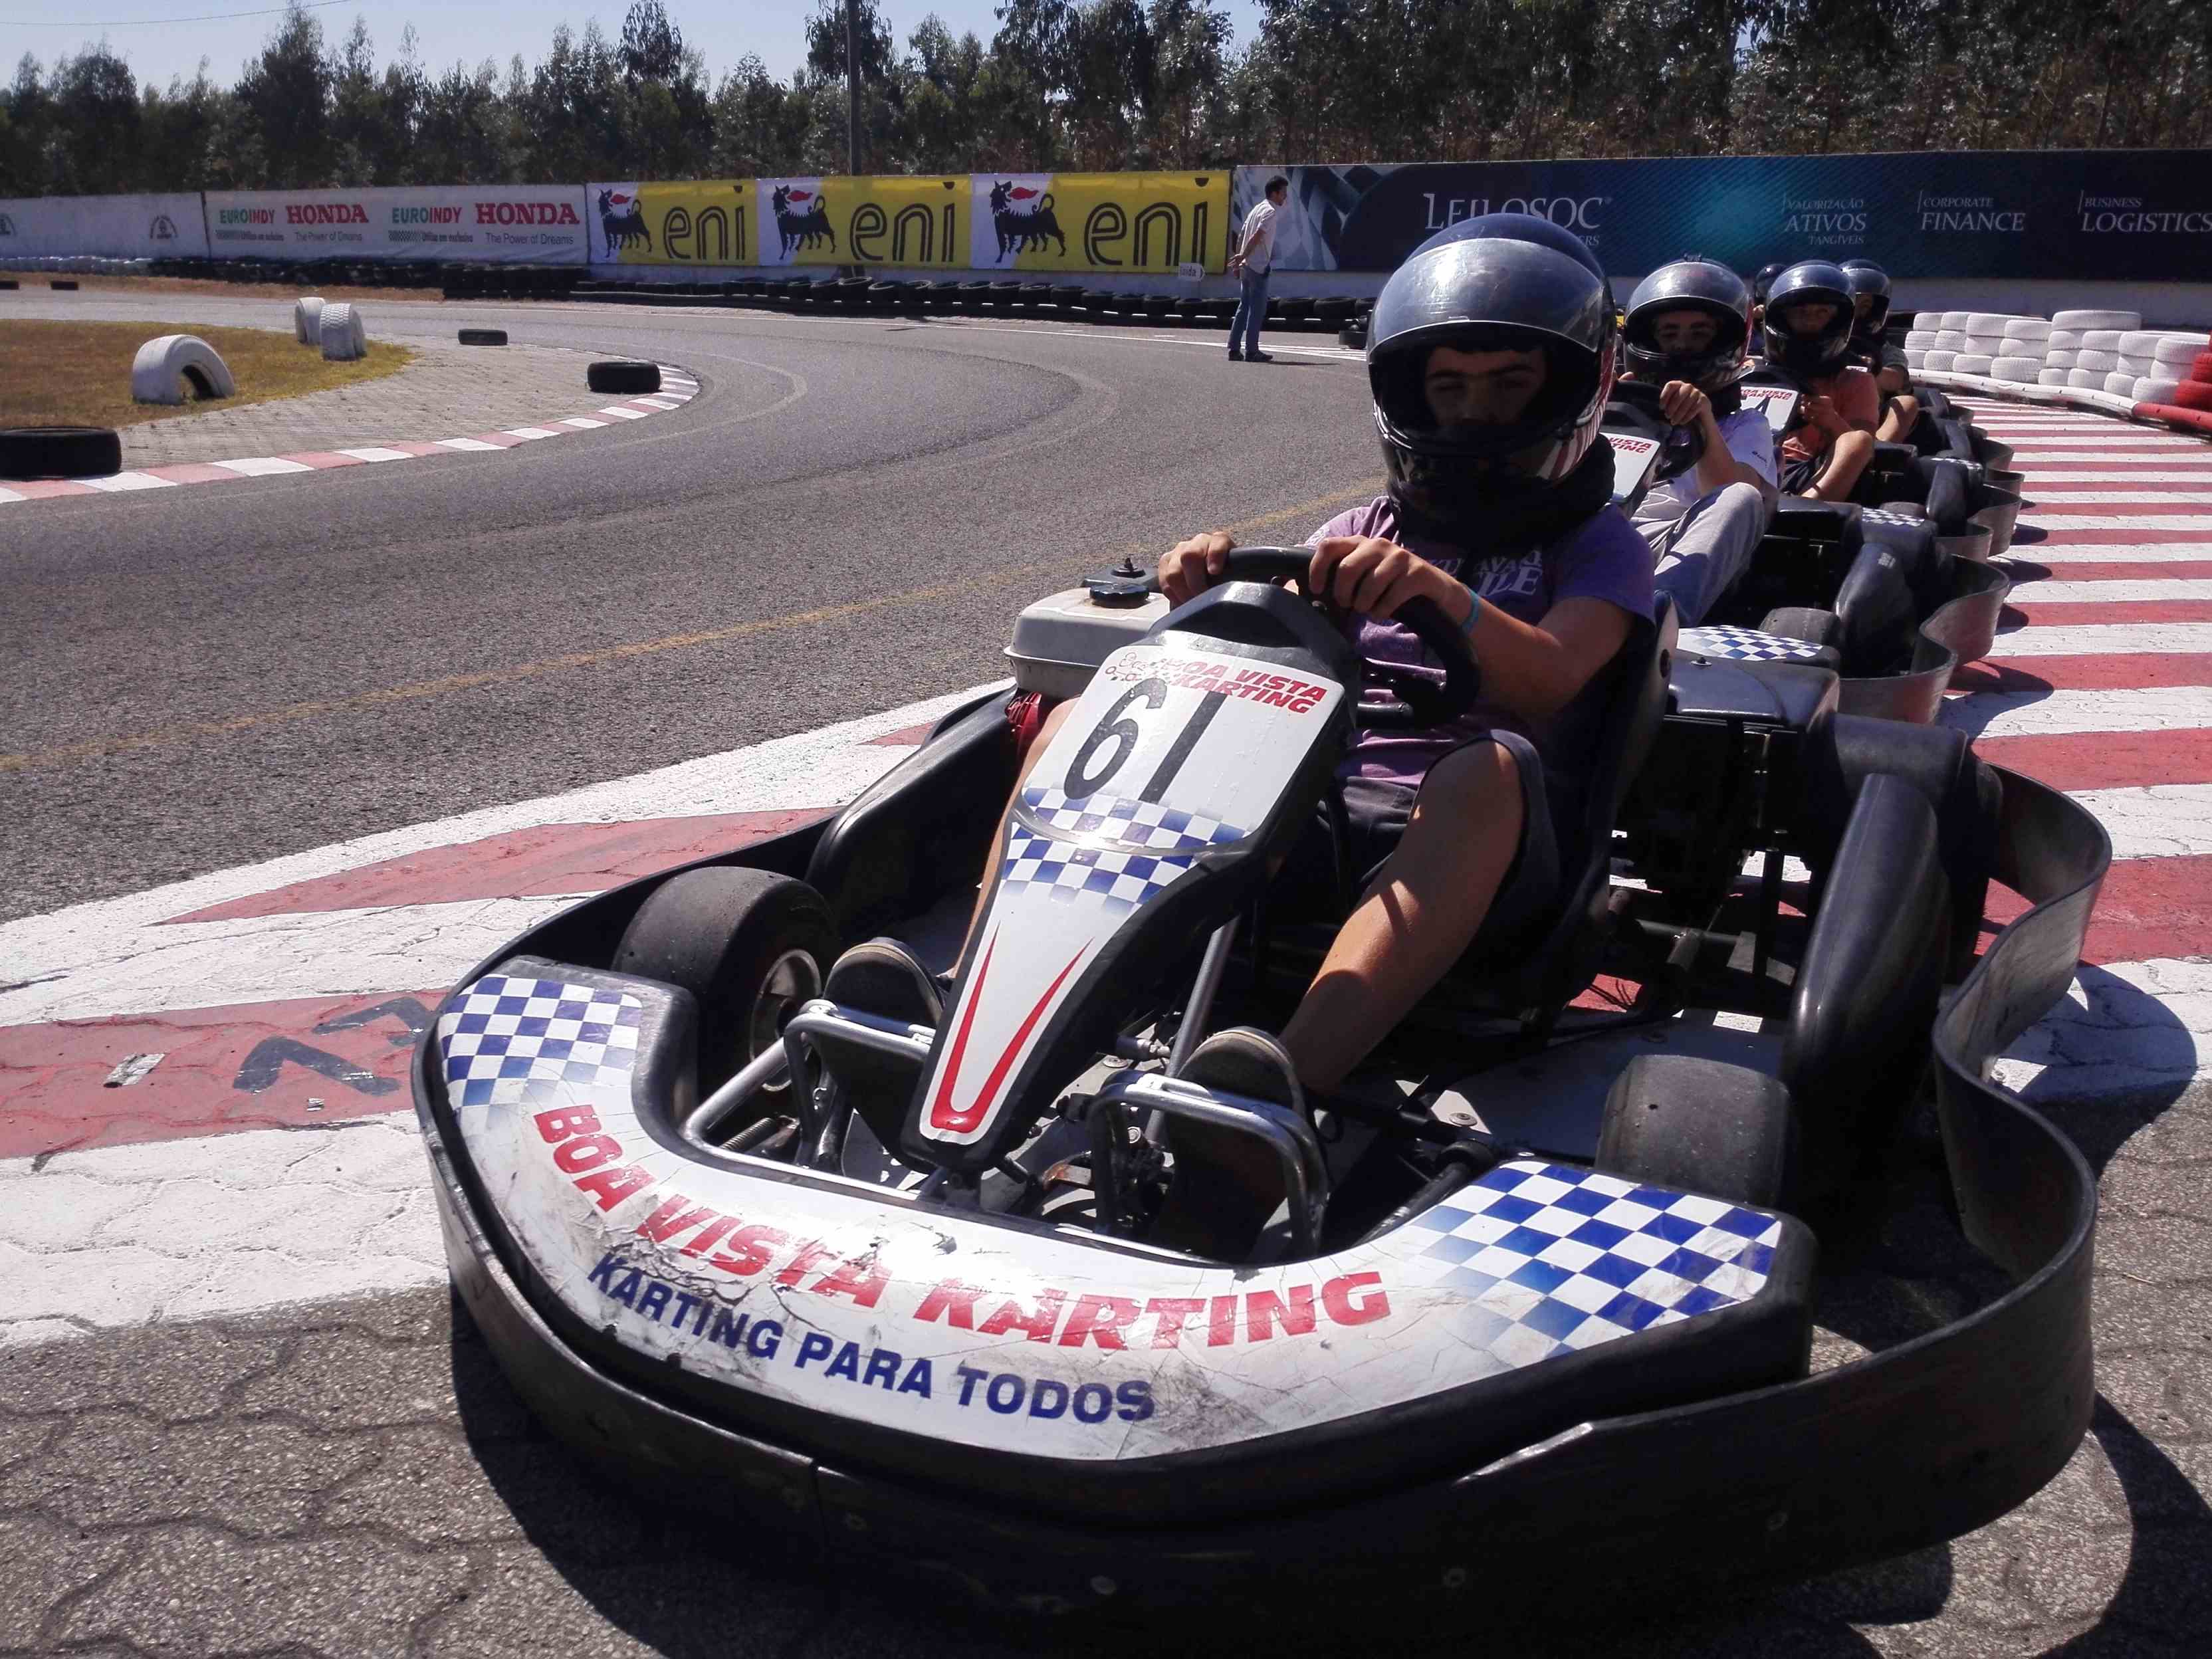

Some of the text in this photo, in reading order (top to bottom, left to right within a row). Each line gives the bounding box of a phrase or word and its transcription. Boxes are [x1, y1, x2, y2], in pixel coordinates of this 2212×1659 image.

[1923, 197, 1995, 207] CORPORATE
[2084, 196, 2143, 207] BUSINESS
[219, 209, 275, 224] EUROINDY
[286, 204, 369, 225] HONDA
[391, 207, 463, 224] EUROINDY
[475, 202, 580, 225] HONDA
[663, 185, 744, 260] eni
[850, 181, 954, 262] eni
[1084, 177, 1208, 266] eni
[1784, 213, 1867, 232] ATIVOS
[1919, 212, 2027, 232] FINANCE
[2080, 212, 2212, 233] LOGISTICS
[485, 233, 574, 245] The Power of Dreams
[1609, 437, 1652, 449] VISTA
[1170, 674, 1317, 715] KARTING
[1235, 669, 1327, 702] VISTA
[1063, 677, 1228, 805] 61
[533, 1104, 1391, 1351] BOA VISTA KARTING
[586, 1252, 1157, 1424] KARTING PARA TODOS
